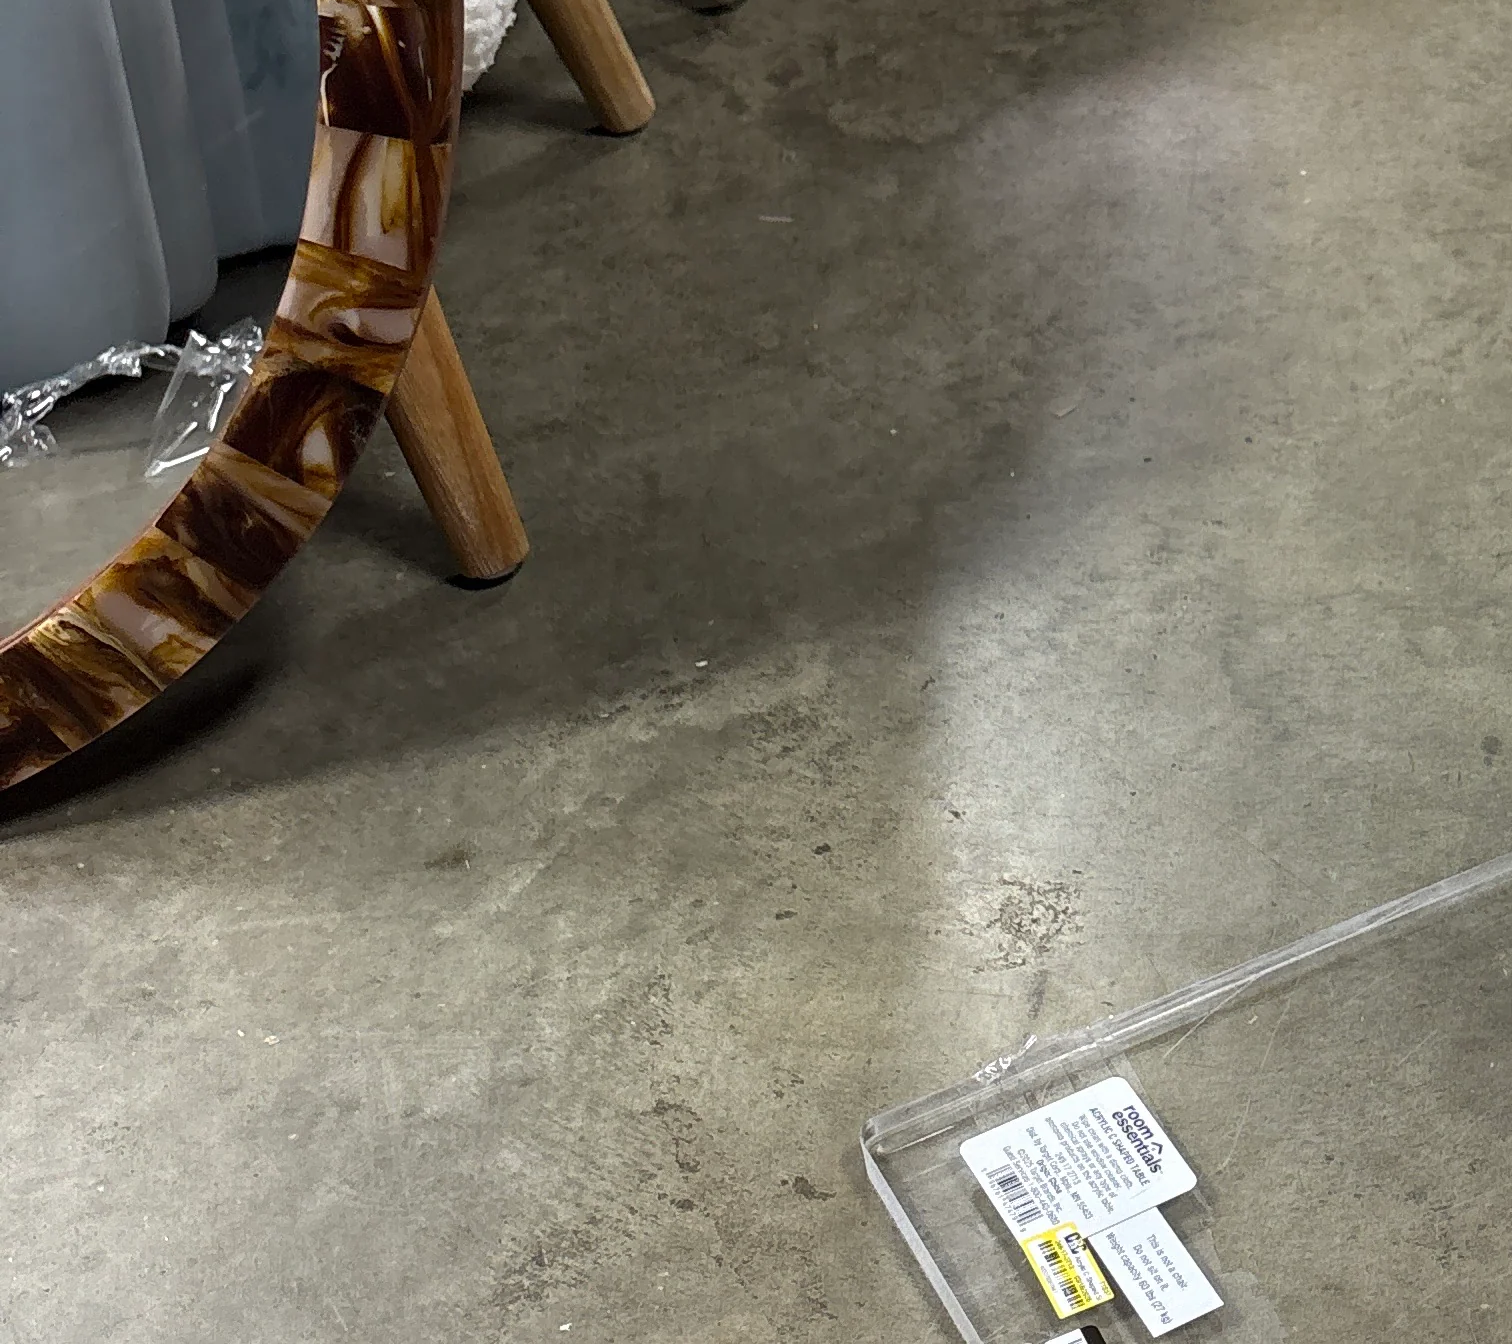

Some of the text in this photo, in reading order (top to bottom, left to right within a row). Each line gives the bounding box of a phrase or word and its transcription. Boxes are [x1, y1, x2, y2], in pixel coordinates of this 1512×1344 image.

[1088, 1107, 1113, 1134] ACRYLIC
[1111, 1138, 1135, 1164] SHAPED
[1130, 1163, 1150, 1186] TABLE
[1111, 1111, 1161, 1173] essentials
[1122, 1105, 1154, 1139] room
